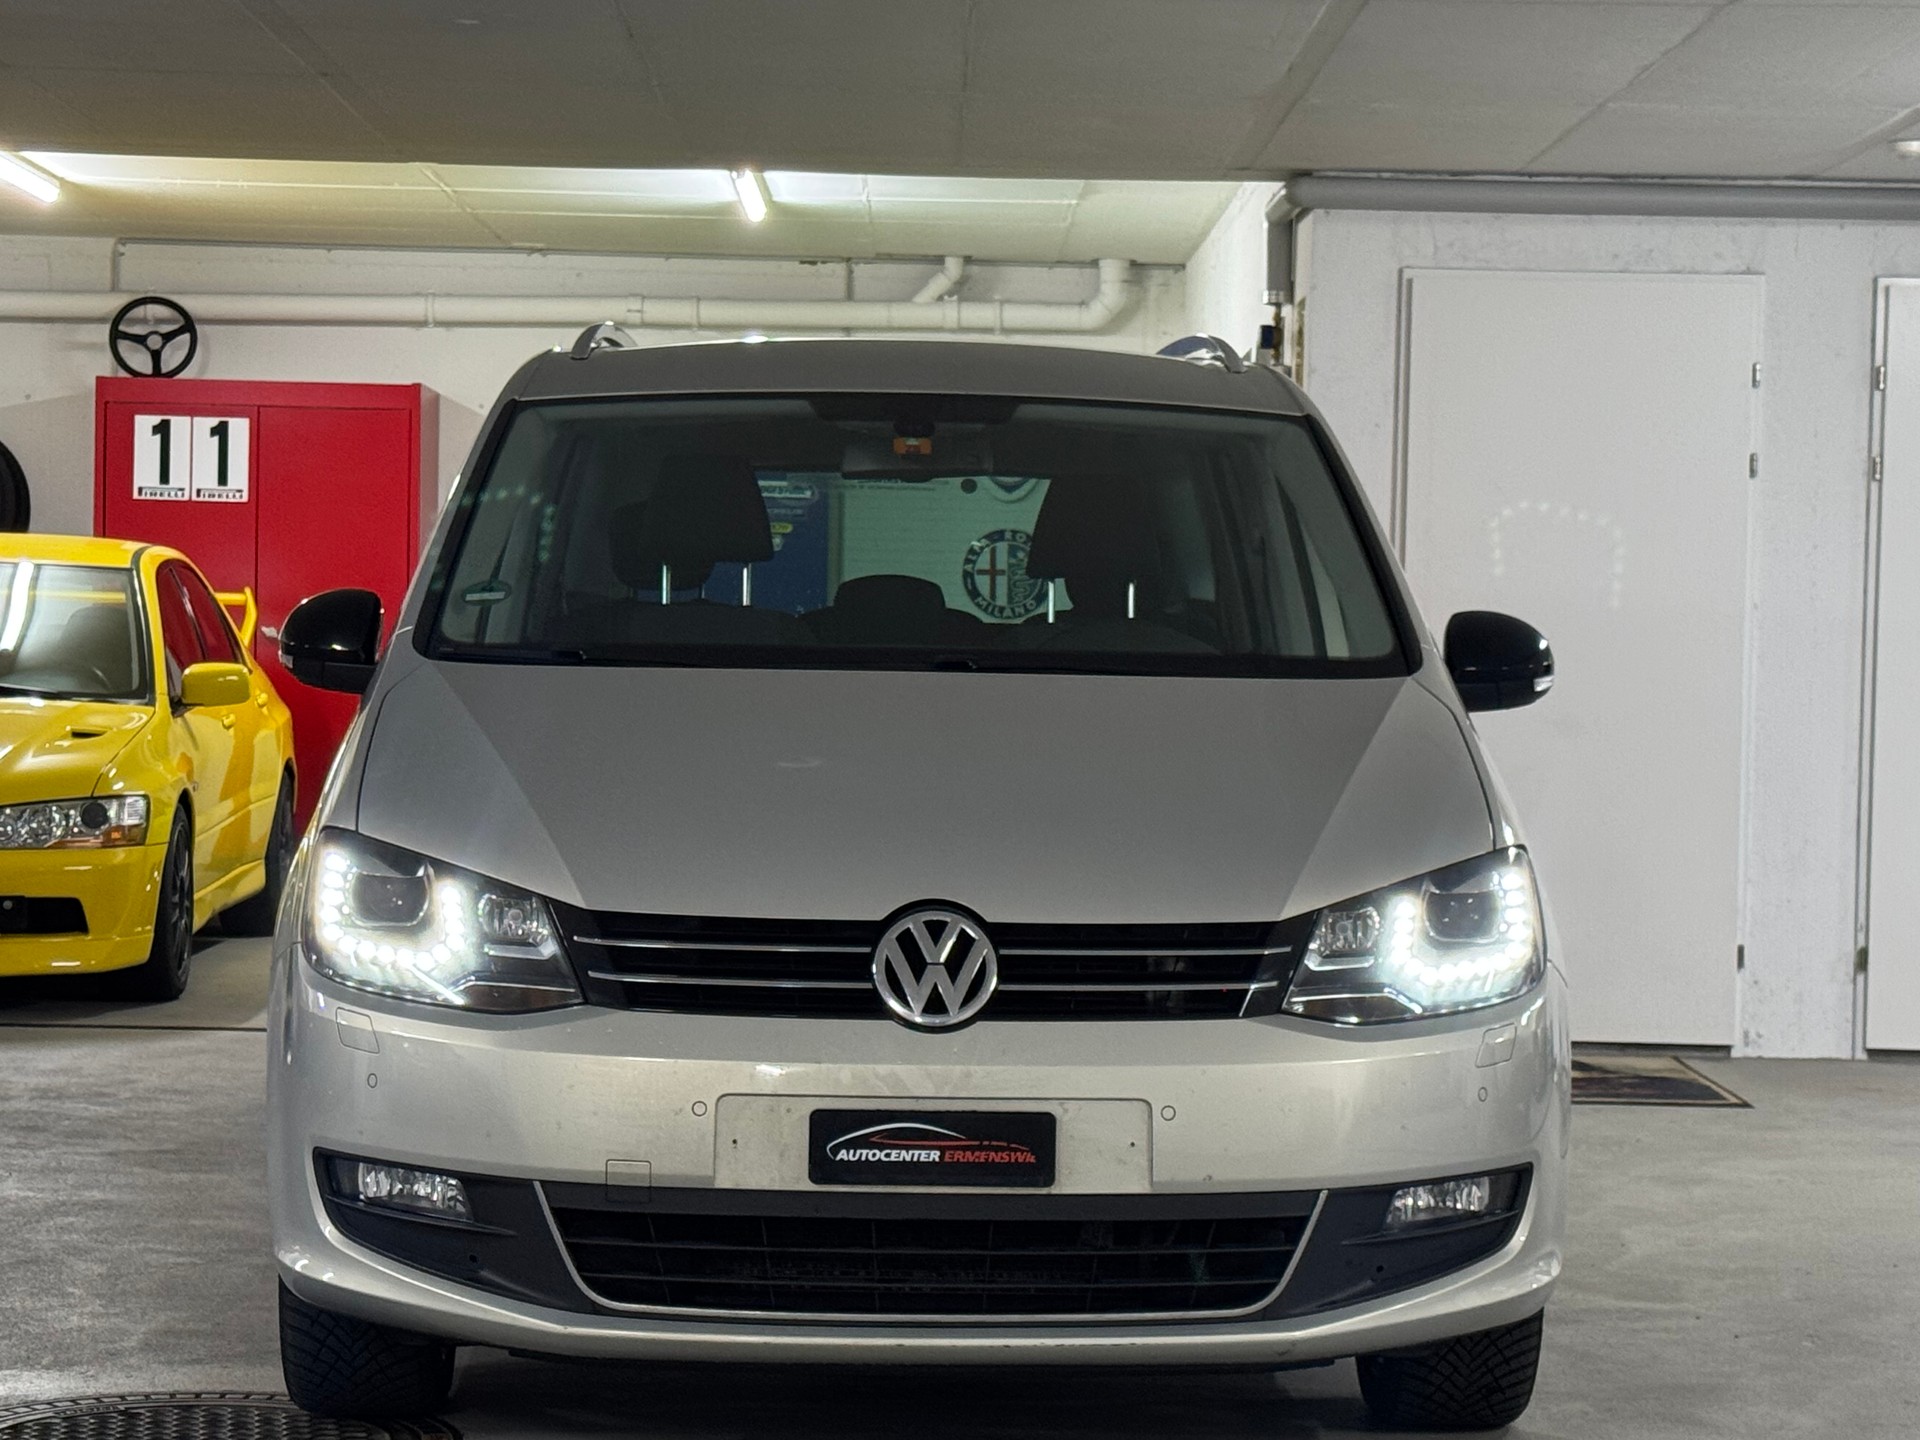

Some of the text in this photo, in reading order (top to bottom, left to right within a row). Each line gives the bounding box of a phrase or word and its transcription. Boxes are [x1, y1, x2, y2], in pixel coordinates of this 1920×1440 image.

[974, 596, 1037, 618] MILANO
[880, 913, 990, 1021] VW
[835, 1149, 940, 1162] AUTOCENTER
